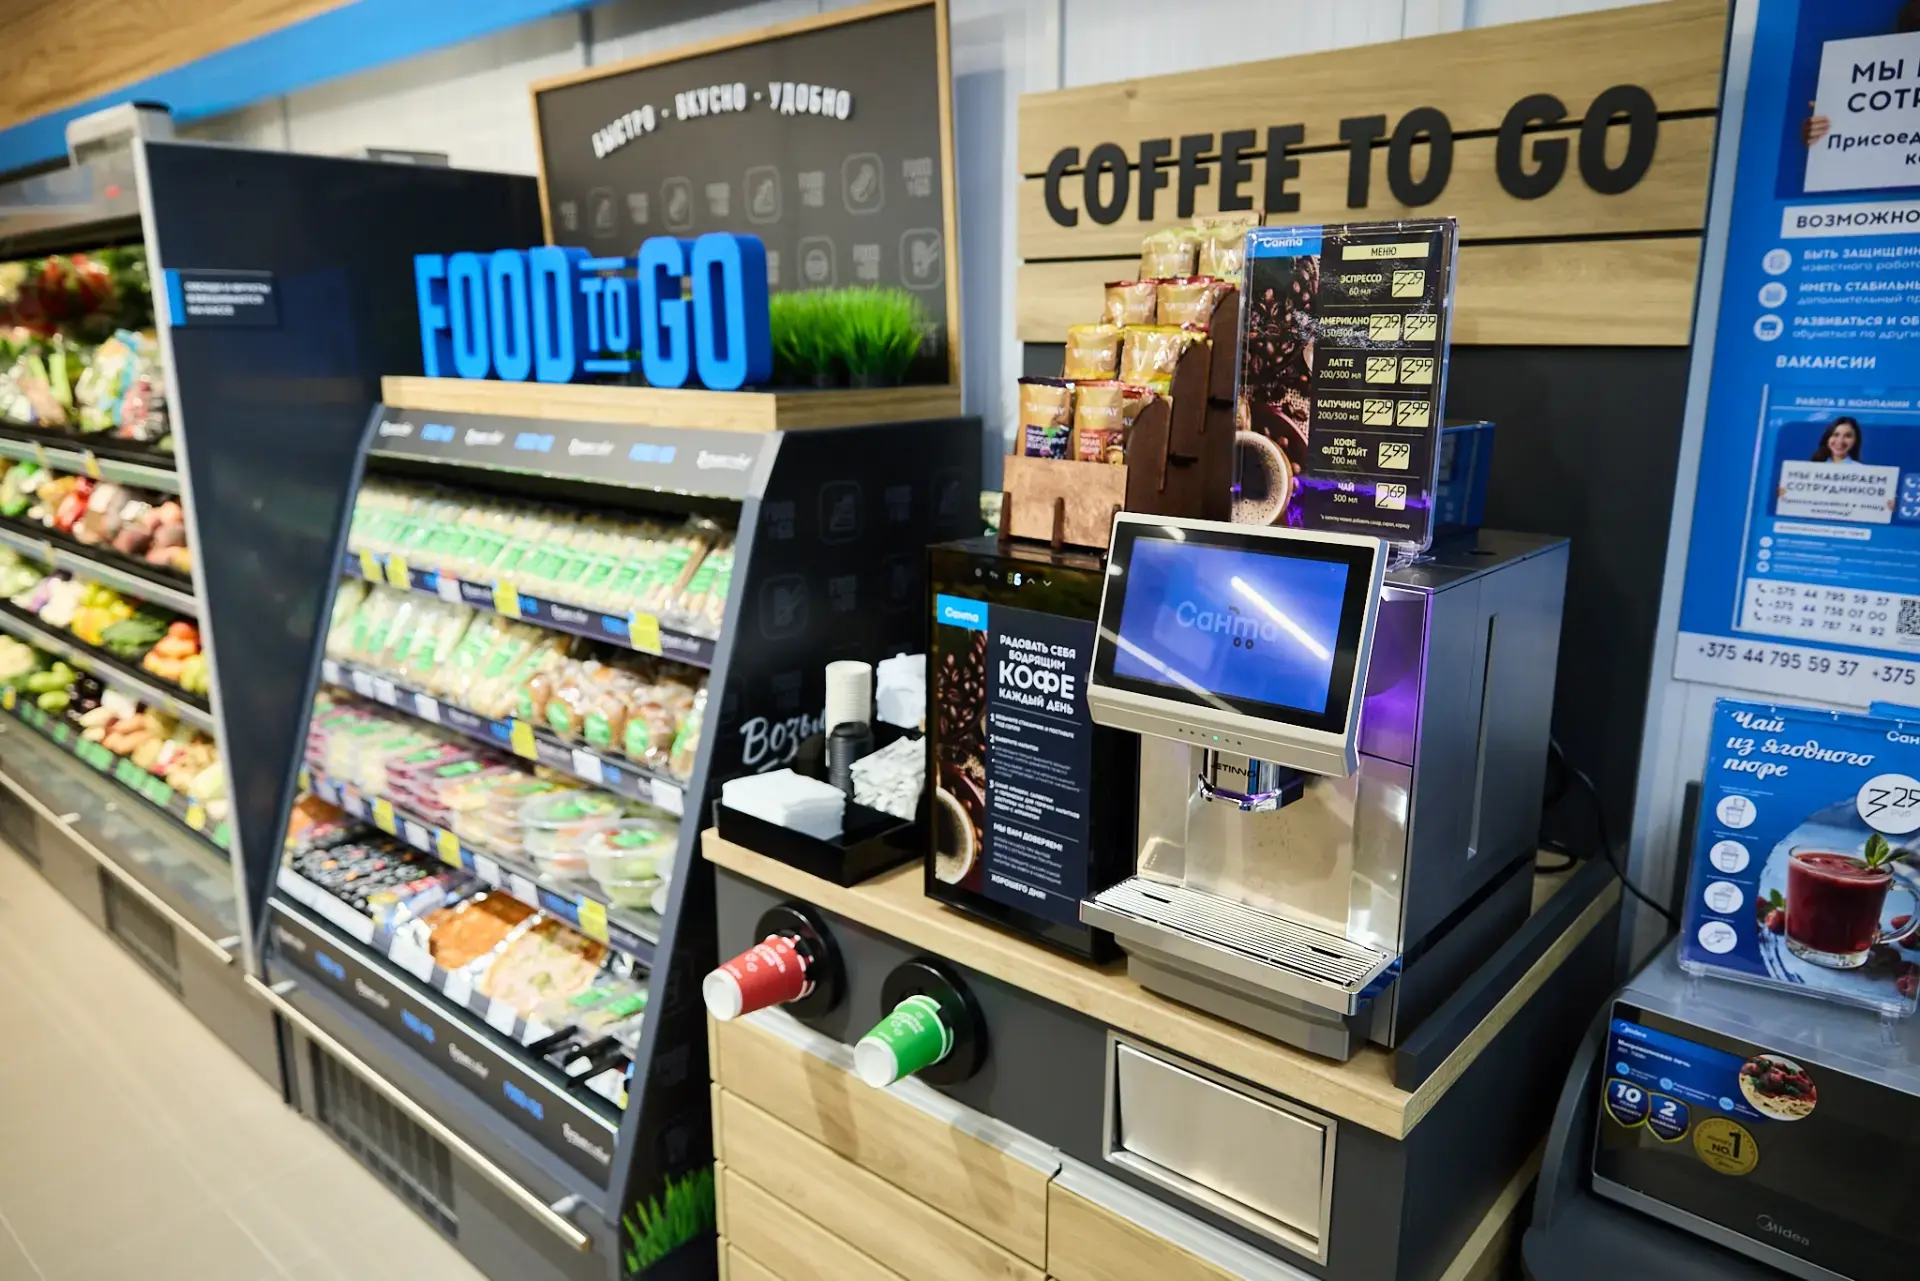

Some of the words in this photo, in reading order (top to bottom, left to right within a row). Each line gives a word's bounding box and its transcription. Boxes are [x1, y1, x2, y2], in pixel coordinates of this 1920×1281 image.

[1851, 59, 1904, 84] МЫ
[591, 104, 656, 158] БЫСТРО
[675, 82, 746, 121] ВКУСНО
[768, 82, 851, 120] УДОБНО
[1044, 123, 1305, 227] COFFEE
[1340, 106, 1452, 209] TO
[1495, 84, 1659, 200] GO
[1796, 209, 1920, 229] ВОЗМОЖНО
[1263, 237, 1304, 249] Санта
[1370, 246, 1397, 257] МЕНЮ
[1803, 249, 1838, 260] БЫТЬ
[1340, 274, 1382, 285] ЭСПРЕССО
[1799, 282, 1841, 292] ИМЕТЬ
[1348, 287, 1359, 296] 60
[413, 245, 580, 384] FOOD
[580, 277, 631, 352] TO
[638, 232, 753, 390] GO
[1319, 316, 1369, 326] АМЕРИКАНО
[1793, 315, 1883, 327] РАЗВИВАТЬСЯ
[1886, 316, 1896, 326] И
[1328, 358, 1354, 368] ЛАТТЕ
[1776, 355, 1876, 369] ВАКАНСИИ
[1317, 399, 1361, 410] КАПУЧИНО
[1333, 438, 1357, 447] КОФЕ
[1321, 446, 1344, 455] ФЛЭТ
[1347, 447, 1368, 457] УАЙТ
[1332, 456, 1345, 464] 200
[1337, 482, 1355, 492] ЧАЙ
[1815, 472, 1888, 485] НАБИРАЕМ
[1786, 481, 1886, 496] СОТРУДНИКОВ
[944, 606, 980, 623] Санта
[1176, 600, 1278, 643] Санта
[1000, 634, 1049, 653] РАДОВАТЬ
[1050, 645, 1076, 659] СЕБЯ
[1009, 649, 1066, 671] БОДРЯЩИМ
[1699, 642, 1737, 661] +375
[1742, 647, 1764, 664] 44
[1768, 650, 1802, 670] 795
[1807, 655, 1831, 673] 59
[1836, 659, 1860, 677] 37
[1872, 665, 1917, 686] +375
[999, 660, 1075, 700] КОФЕ
[999, 687, 1044, 708] КАЖДЫЙ
[1046, 699, 1074, 715] ДЕНЬ
[1731, 711, 1786, 733] Чай
[989, 734, 995, 743] 2
[1726, 736, 1756, 757] из
[1761, 739, 1875, 767] ягодного
[1723, 757, 1789, 780] пюре
[993, 822, 1006, 833] МЫ
[1006, 826, 1022, 838] ВАМ
[1022, 832, 1063, 852] ДОВЕРЯЕМ!
[991, 873, 1028, 893] ХОРОШЕГО
[1617, 1084, 1642, 1103] 10
[1660, 1101, 1677, 1117] 2
[1729, 1132, 1741, 1158] 1
[1758, 1215, 1809, 1246] Midea
